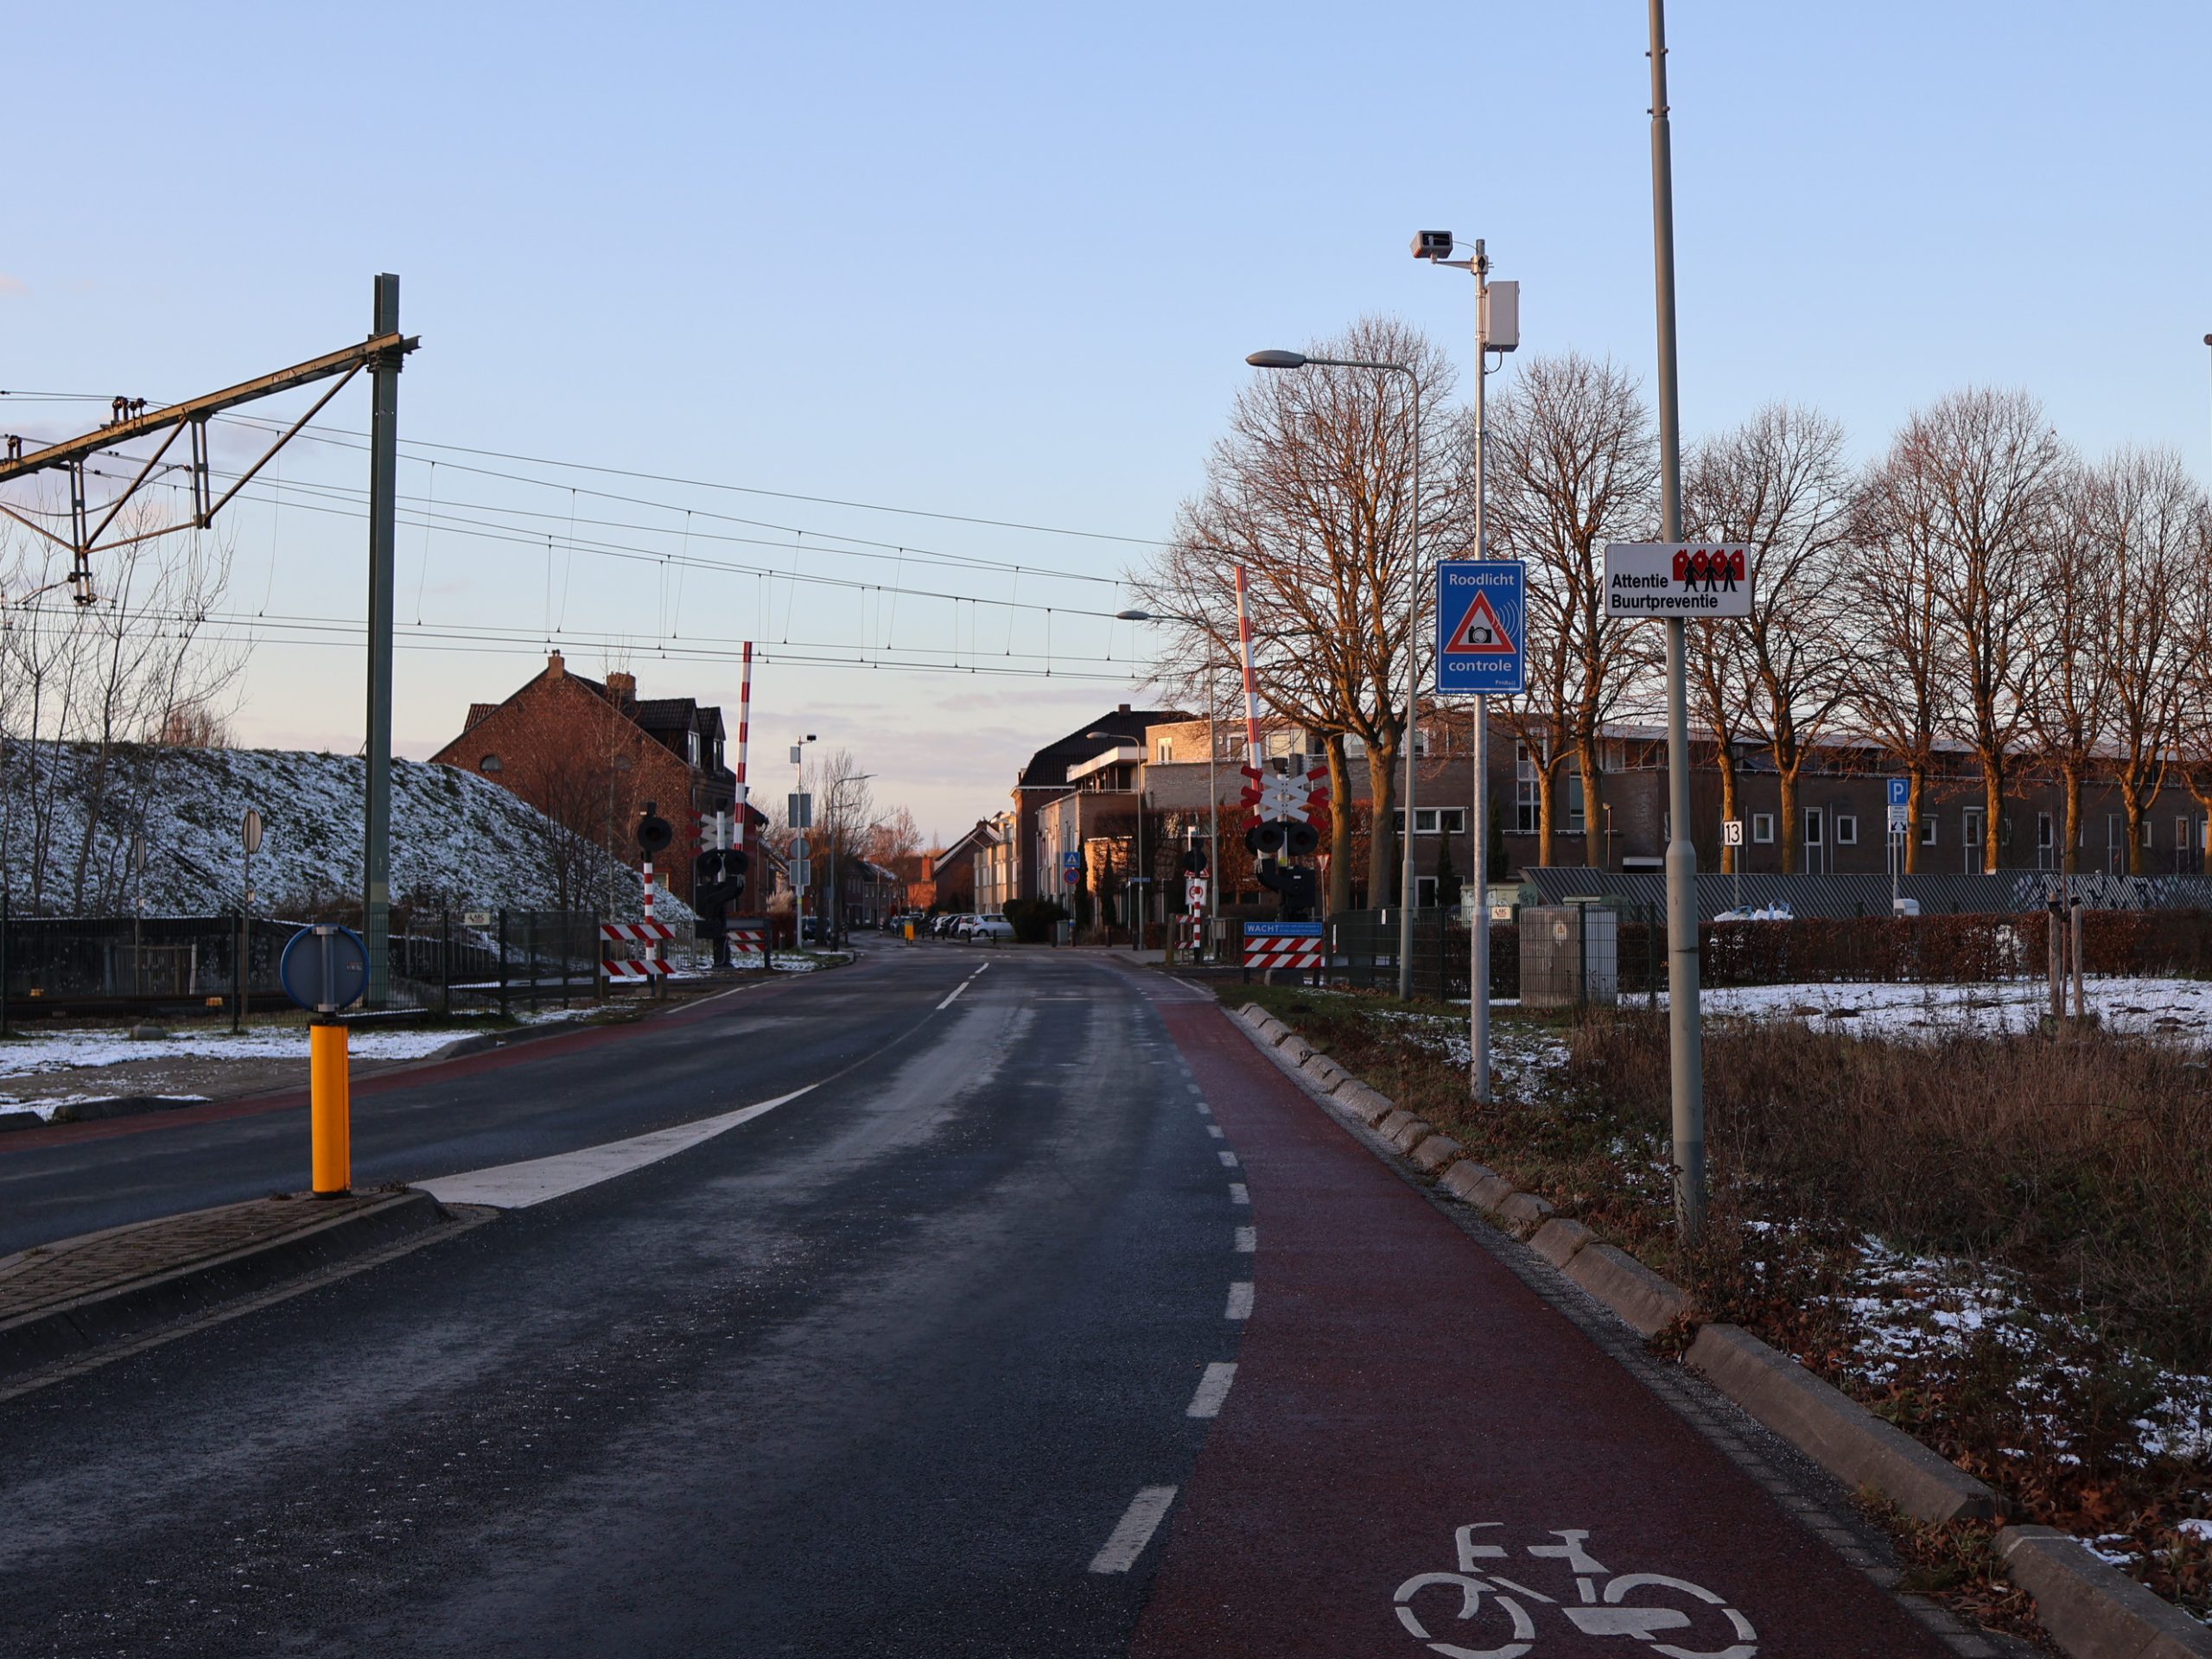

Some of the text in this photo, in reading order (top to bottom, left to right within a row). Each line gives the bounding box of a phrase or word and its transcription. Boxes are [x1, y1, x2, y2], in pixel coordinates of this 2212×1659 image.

[1449, 574, 1515, 586] Roodlicht
[1611, 574, 1669, 588] Attentie
[1611, 594, 1719, 611] Buurtpreventie
[1448, 659, 1512, 671] controle
[1893, 782, 1904, 803] P
[1726, 823, 1740, 843] 13
